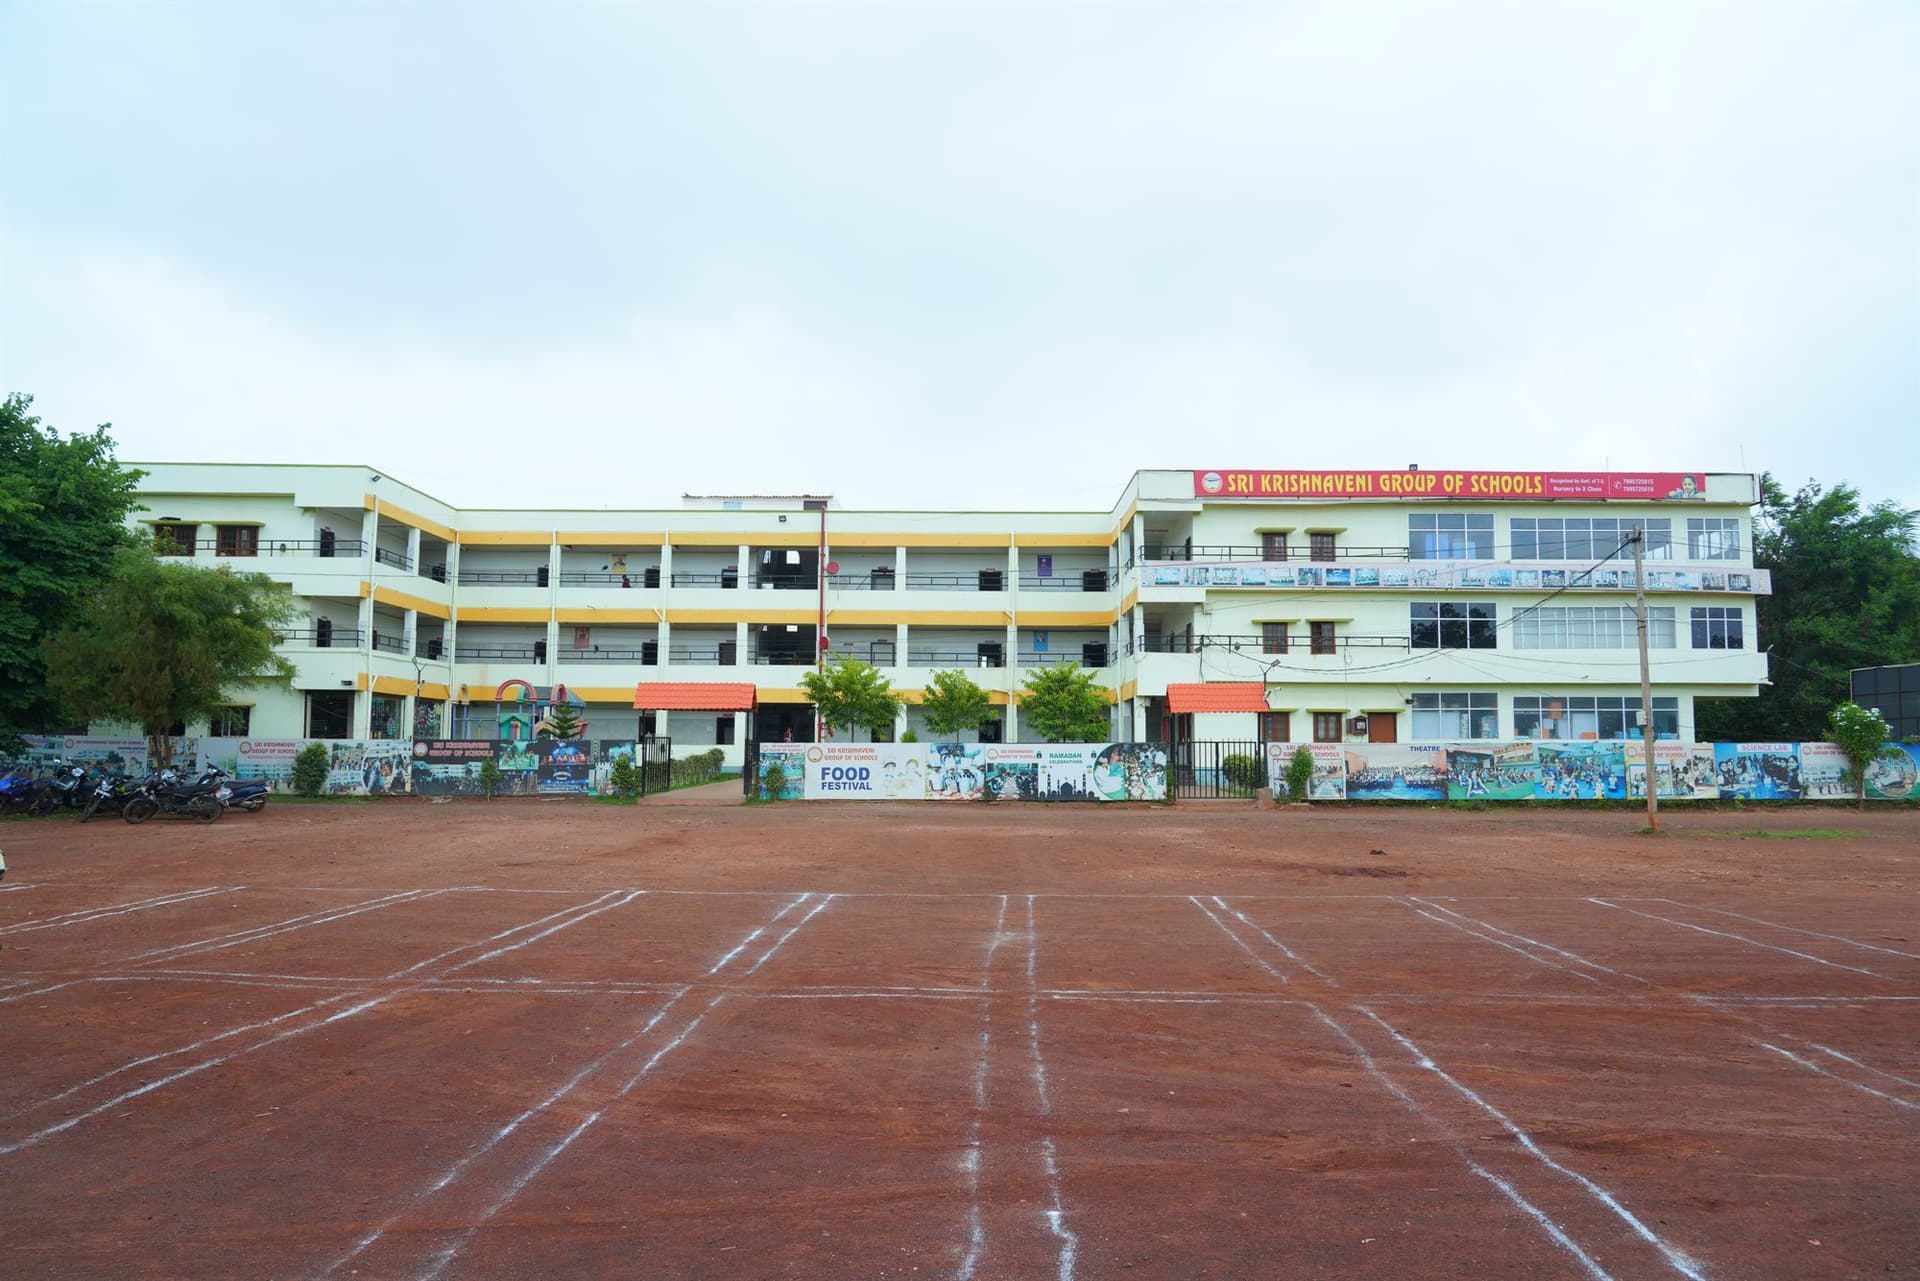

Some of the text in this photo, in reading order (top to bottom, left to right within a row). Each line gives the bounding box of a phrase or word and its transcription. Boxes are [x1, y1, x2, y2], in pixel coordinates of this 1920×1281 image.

[1227, 474, 1542, 494] SRI KRISHNAVENI GROUP OF SCHOOLS
[821, 767, 871, 781] FOOD
[821, 782, 873, 791] FESTIVAL
